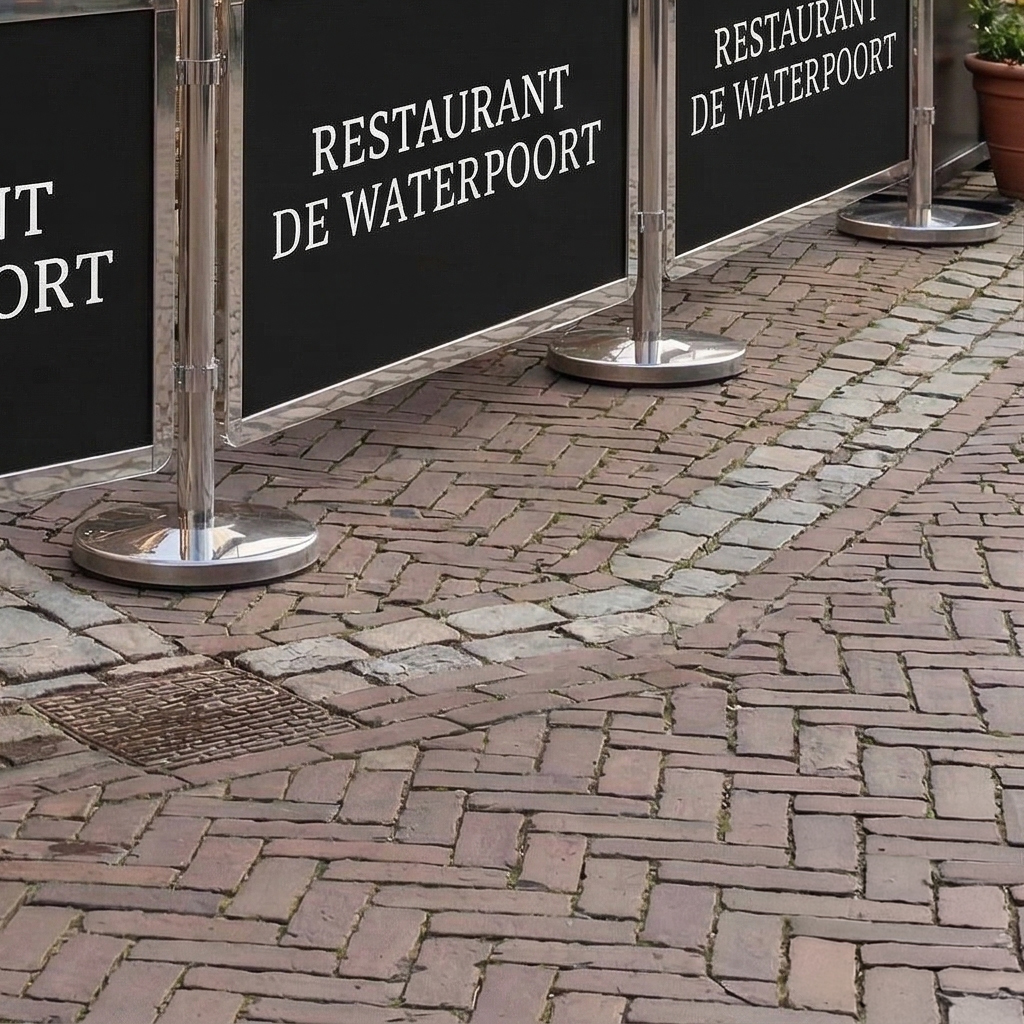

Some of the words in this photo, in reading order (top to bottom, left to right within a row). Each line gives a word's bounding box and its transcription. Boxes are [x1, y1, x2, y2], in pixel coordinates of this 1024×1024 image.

[312, 63, 570, 177] RESTAURANT
[690, 86, 726, 137] DE
[732, 31, 897, 120] WATERPOORT
[272, 197, 330, 261] DE
[341, 119, 602, 237] WATERPOORT
